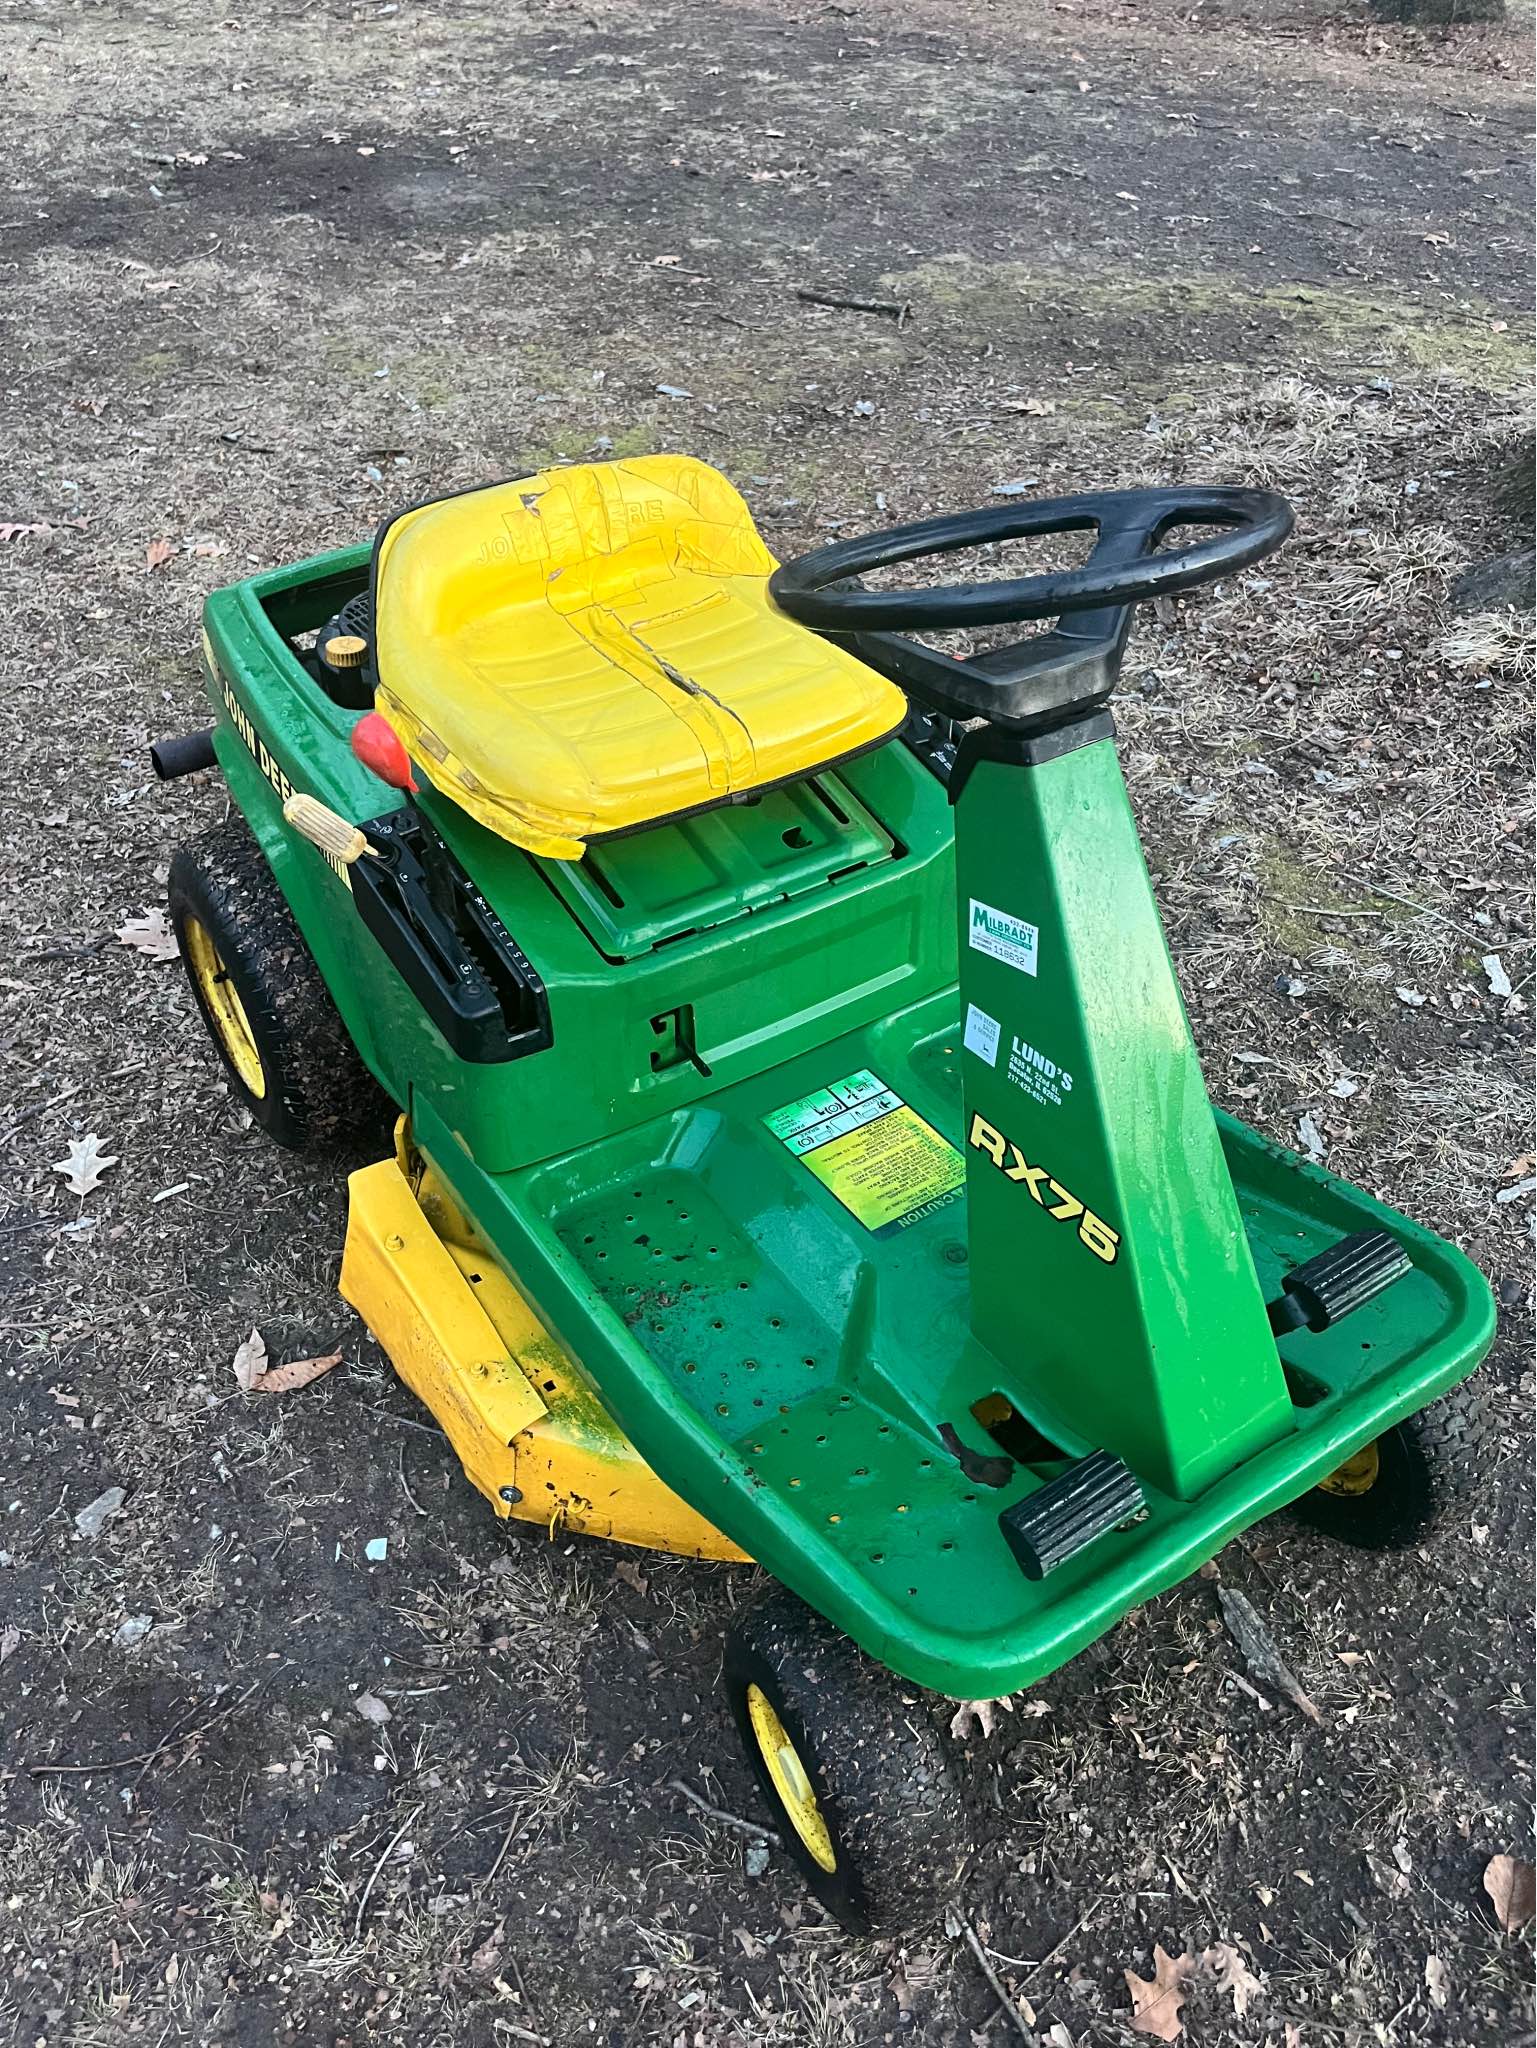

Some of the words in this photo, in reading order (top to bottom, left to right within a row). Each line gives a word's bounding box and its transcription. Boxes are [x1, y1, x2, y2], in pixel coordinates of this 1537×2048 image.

[223, 681, 256, 757] JOHN
[259, 740, 297, 803] DEE
[973, 906, 1033, 944] MILBRADT
[1012, 1035, 1073, 1091] LUND'S
[898, 1192, 956, 1228] CAUTION
[968, 1112, 1121, 1264] RX75
